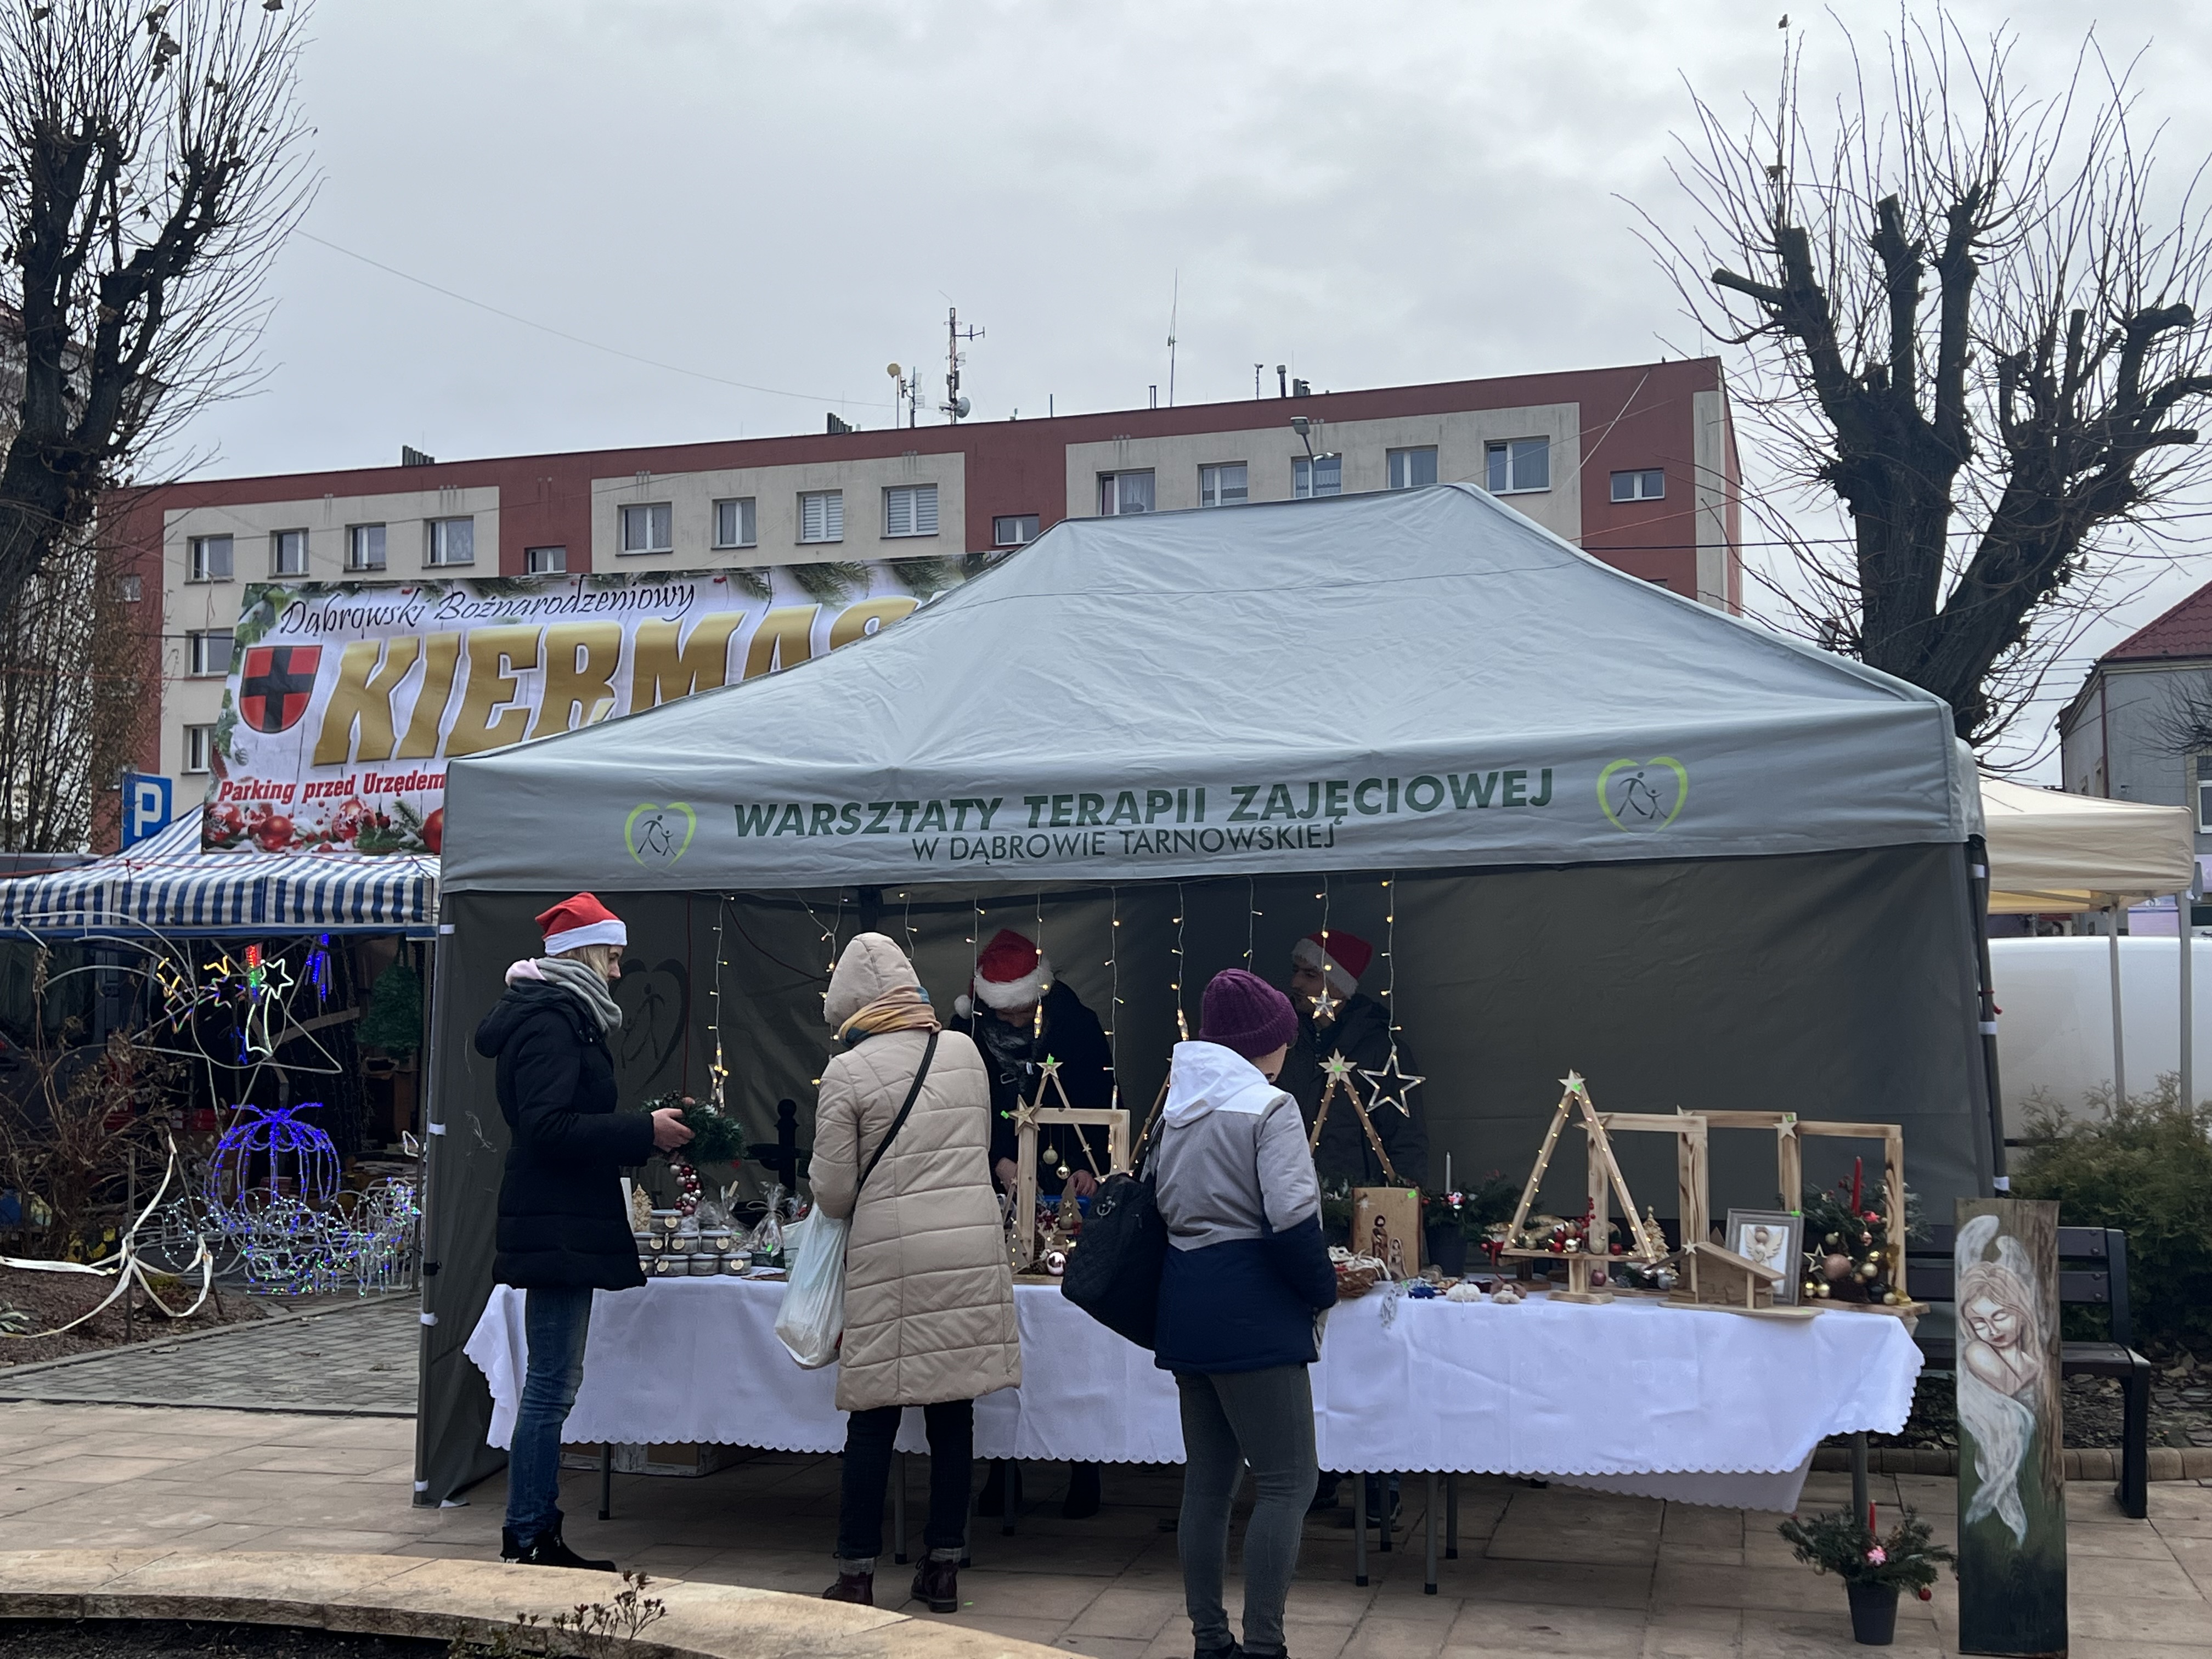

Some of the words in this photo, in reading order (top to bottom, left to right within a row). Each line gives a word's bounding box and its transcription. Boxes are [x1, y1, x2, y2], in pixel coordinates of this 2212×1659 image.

[280, 587, 431, 636] Dąbrowski
[134, 782, 163, 837] P
[218, 780, 296, 804] Parking
[301, 774, 356, 804] przed
[363, 770, 446, 797] Urzędem
[734, 797, 1003, 837] WARSZTATY
[1024, 788, 1205, 828] TERAPII
[1227, 768, 1551, 824] ZAJĘCIOWEJ
[912, 837, 940, 861] W
[950, 831, 1105, 865] DĄBROWIE
[1119, 824, 1335, 855] TARNOWSKIEJ
